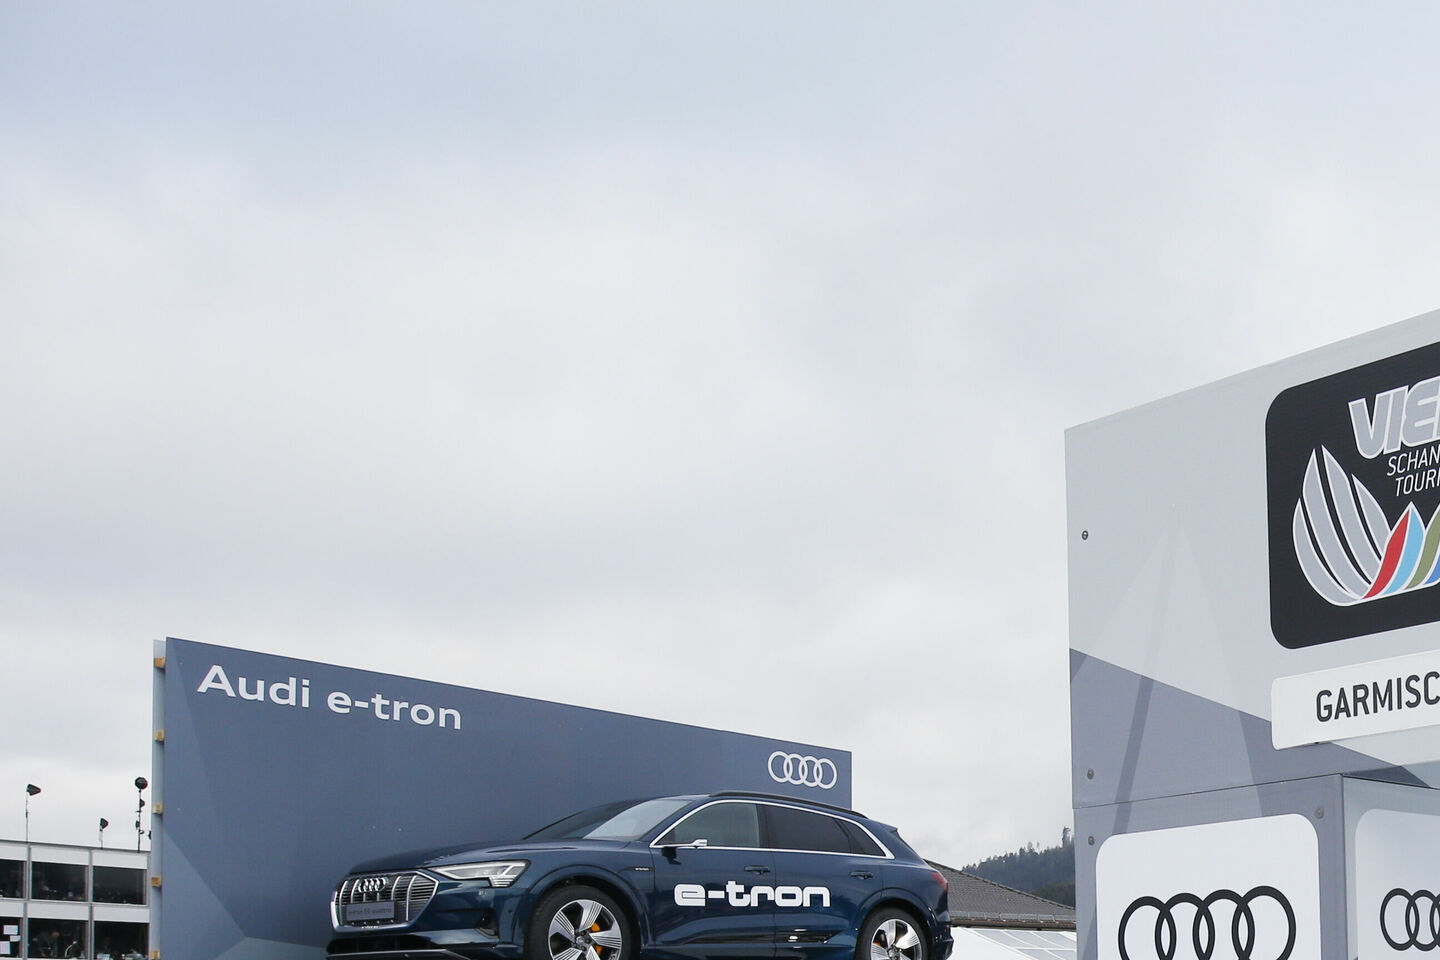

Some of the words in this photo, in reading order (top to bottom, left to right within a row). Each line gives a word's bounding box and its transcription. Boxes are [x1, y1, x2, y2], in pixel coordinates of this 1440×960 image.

[197, 664, 310, 708] Audi
[326, 690, 462, 730] e-tron
[674, 880, 831, 908] e-tron
